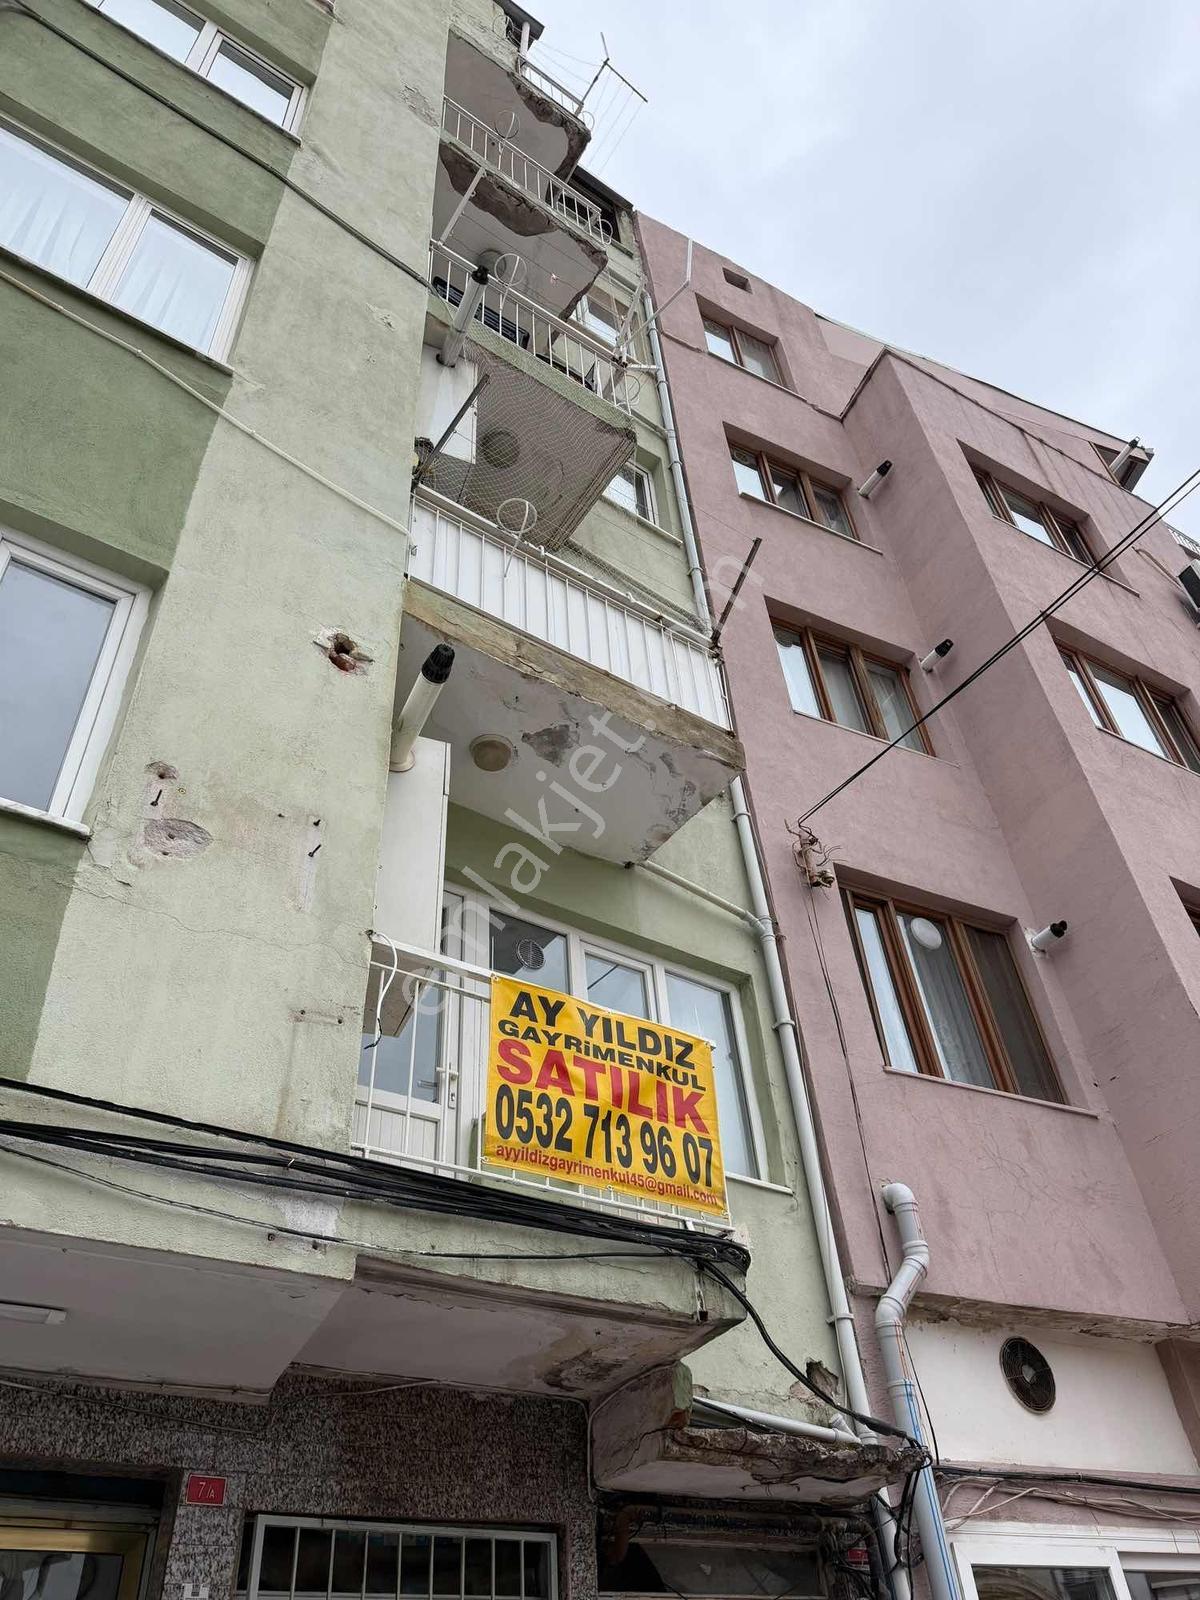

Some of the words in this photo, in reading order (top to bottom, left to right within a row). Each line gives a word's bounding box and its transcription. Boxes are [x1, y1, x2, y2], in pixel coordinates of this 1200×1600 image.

[509, 991, 566, 1027] AY
[577, 1007, 695, 1070] YILDIZ
[496, 1038, 710, 1135] SATILIK
[495, 1083, 573, 1153] 0532
[583, 1103, 633, 1169] 713
[640, 1120, 677, 1179] 96
[682, 1132, 714, 1188] 07
